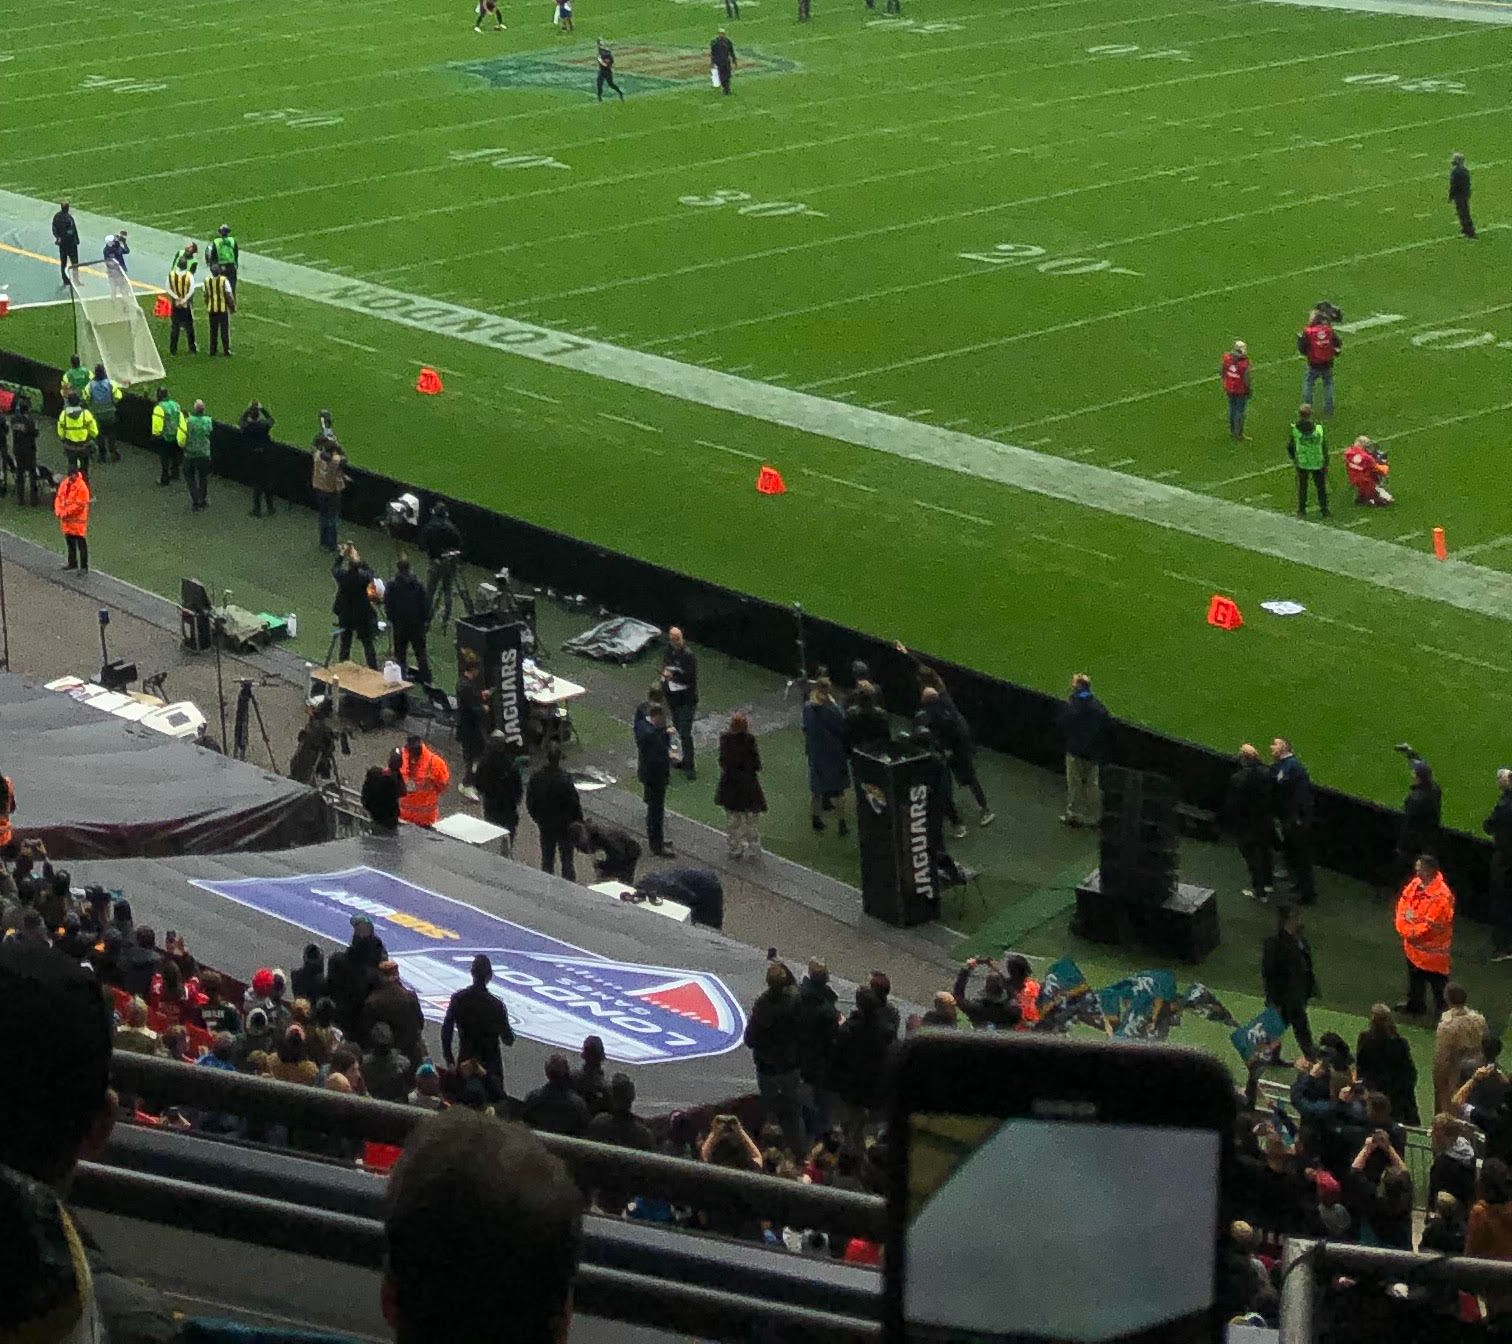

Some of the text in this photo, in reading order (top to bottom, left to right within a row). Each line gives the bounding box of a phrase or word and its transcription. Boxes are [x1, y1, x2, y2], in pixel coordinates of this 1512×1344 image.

[318, 284, 591, 356] LONDON
[501, 648, 524, 747] JAGUARS
[909, 785, 934, 899] JAGUARS
[556, 977, 651, 1016] GAMES
